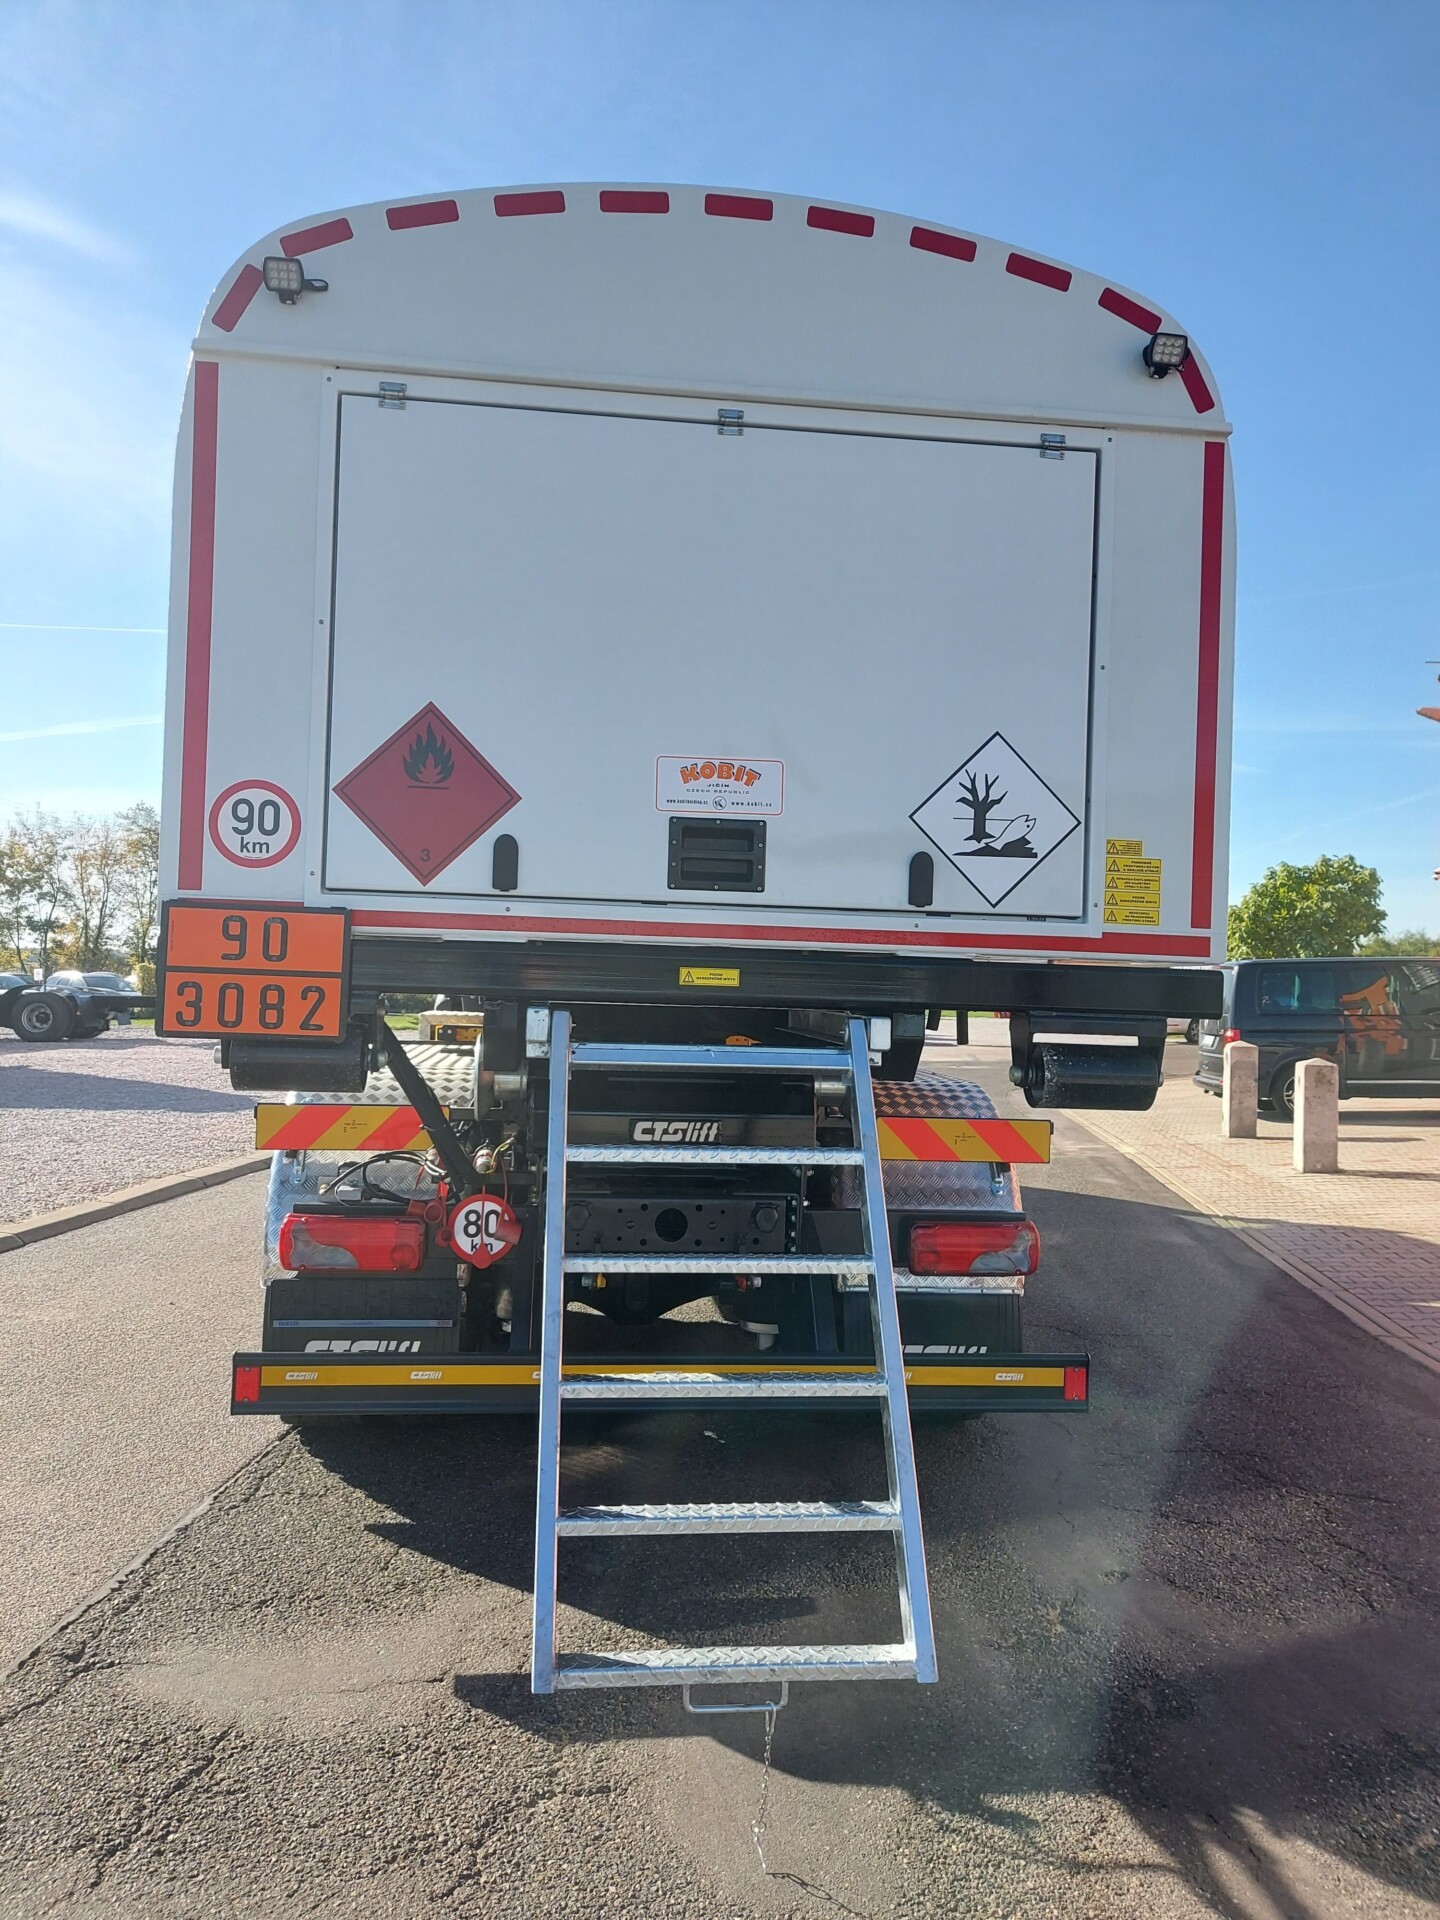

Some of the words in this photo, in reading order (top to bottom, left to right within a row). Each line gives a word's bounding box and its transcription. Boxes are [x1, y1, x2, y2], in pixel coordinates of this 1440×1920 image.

[680, 761, 762, 788] KOBIT
[231, 797, 281, 836] 90
[240, 836, 270, 854] km
[420, 848, 431, 863] 3
[221, 914, 289, 963] 90
[175, 980, 327, 1032] 3082
[633, 1121, 719, 1142] CTSlift
[463, 1209, 503, 1239] 80
